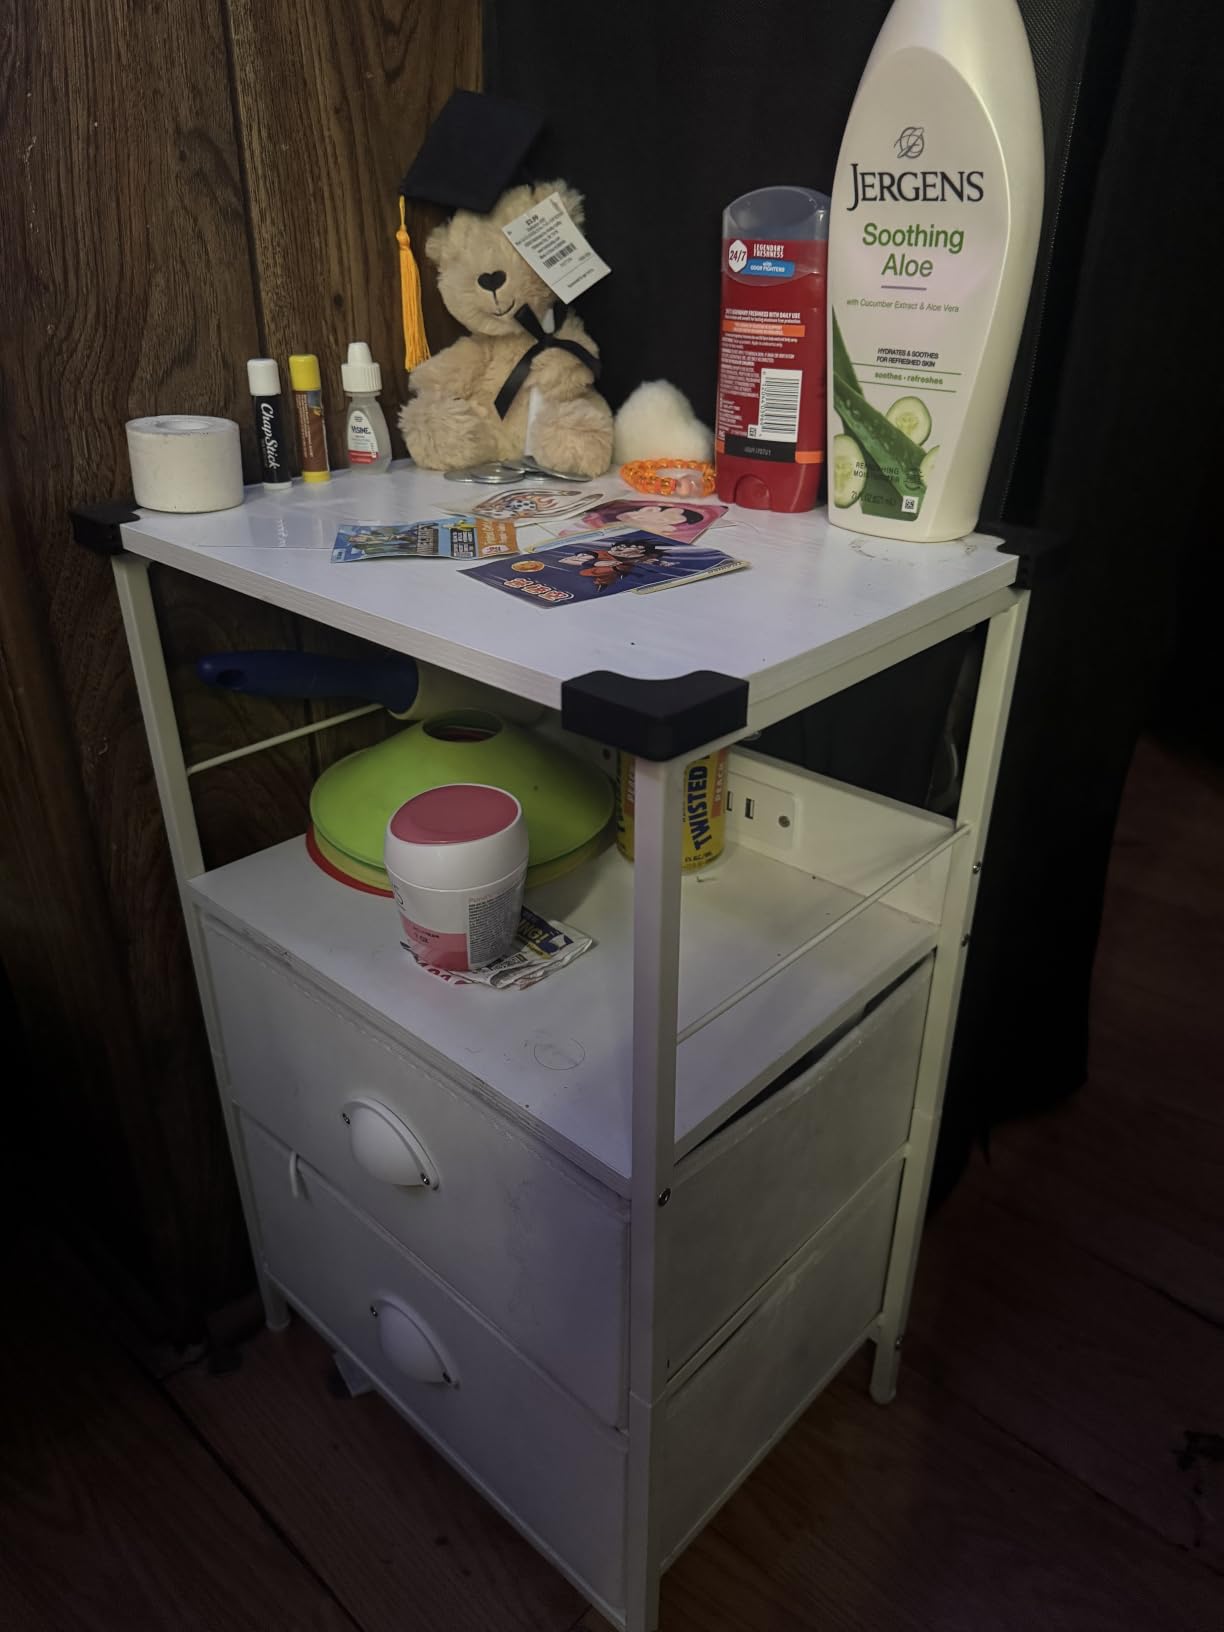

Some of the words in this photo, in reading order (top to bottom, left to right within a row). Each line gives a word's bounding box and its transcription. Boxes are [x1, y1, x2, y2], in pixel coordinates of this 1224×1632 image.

[846, 163, 984, 211] JERGENS
[862, 222, 964, 254] Soothing
[753, 243, 785, 252] LEGENDARY
[753, 250, 784, 259] FRESHNESS
[729, 250, 747, 262] 24/7
[881, 253, 933, 278] Aloe
[860, 298, 893, 308] Cucumber
[894, 301, 918, 310] Extract
[919, 303, 925, 311] &
[925, 303, 942, 312] Aloe
[943, 304, 960, 313] Vera
[877, 347, 906, 356] HYDRATES
[911, 350, 939, 360] SOOTHES
[888, 357, 921, 366] REFRESHED
[875, 371, 902, 381] soothes
[907, 374, 944, 385] refreshes
[260, 403, 281, 469] ChapStick
[687, 765, 712, 851] TWISTED
